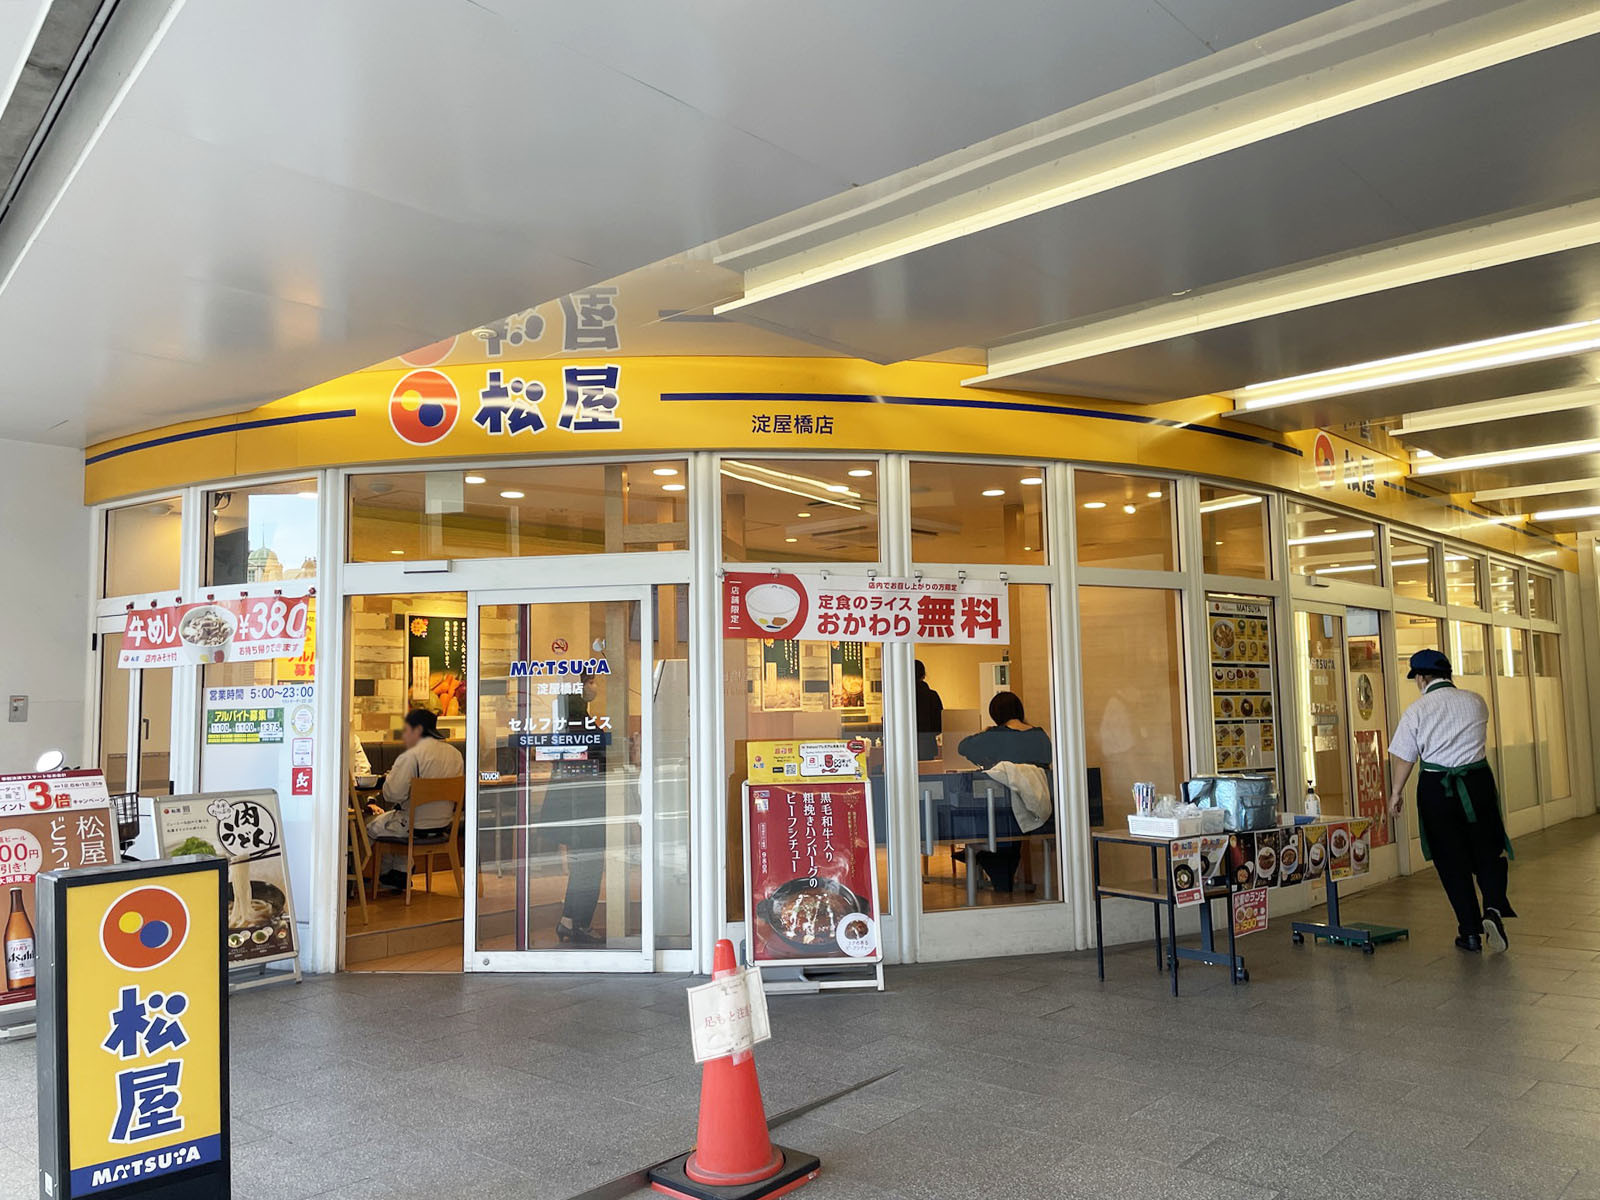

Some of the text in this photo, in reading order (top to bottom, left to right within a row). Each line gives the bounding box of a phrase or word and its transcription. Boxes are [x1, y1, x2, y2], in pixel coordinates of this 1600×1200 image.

[474, 364, 622, 435] 松屋
[752, 414, 834, 435] 淀屋橋店
[730, 586, 740, 624] 店舗限定
[818, 594, 912, 611] 定食のライス
[239, 600, 308, 640] ¥380
[817, 613, 911, 637] おかわり
[917, 595, 1002, 639] 無料
[128, 614, 177, 647] 牛めし
[509, 658, 611, 677] MATSUYA
[209, 688, 244, 700] 営業時間
[537, 682, 584, 696] 淀屋橋店
[214, 709, 267, 722] アルバイト募集
[509, 716, 612, 732] セルフサービス
[520, 734, 601, 746] SELF SERVICE
[481, 771, 499, 780] TOUCH
[234, 802, 260, 828] 肉
[820, 792, 835, 863] 黒毛和牛入り
[76, 815, 108, 866] 松屋
[222, 822, 273, 848] うどん
[786, 791, 801, 873] ビーフシチュー
[803, 792, 819, 888] 粗挽きハンバーグの
[100, 984, 190, 1143] 松屋
[91, 1146, 201, 1187] MATSUYA
